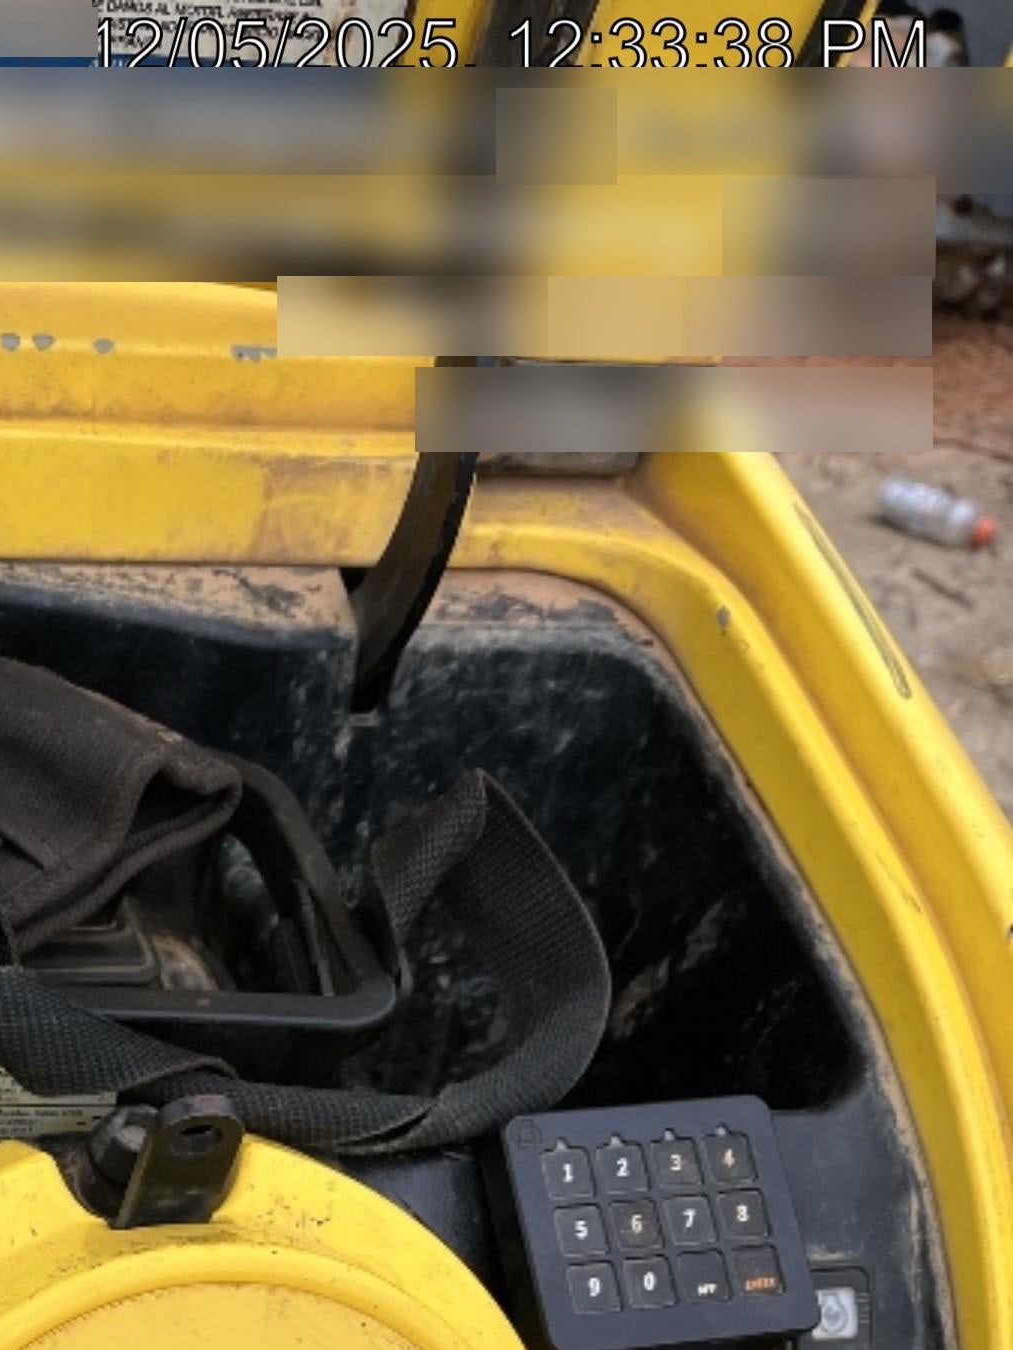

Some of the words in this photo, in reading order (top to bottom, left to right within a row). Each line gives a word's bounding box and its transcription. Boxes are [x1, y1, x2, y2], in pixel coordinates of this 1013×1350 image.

[561, 1163, 574, 1184] 1
[615, 1157, 630, 1178] 2
[669, 1154, 683, 1172] 3
[722, 1148, 737, 1168] 4
[573, 1219, 589, 1241] 5
[630, 1213, 644, 1234] 6
[682, 1208, 697, 1229] 7
[736, 1204, 750, 1223] 8
[588, 1276, 602, 1298] 9
[642, 1271, 657, 1292] 0
